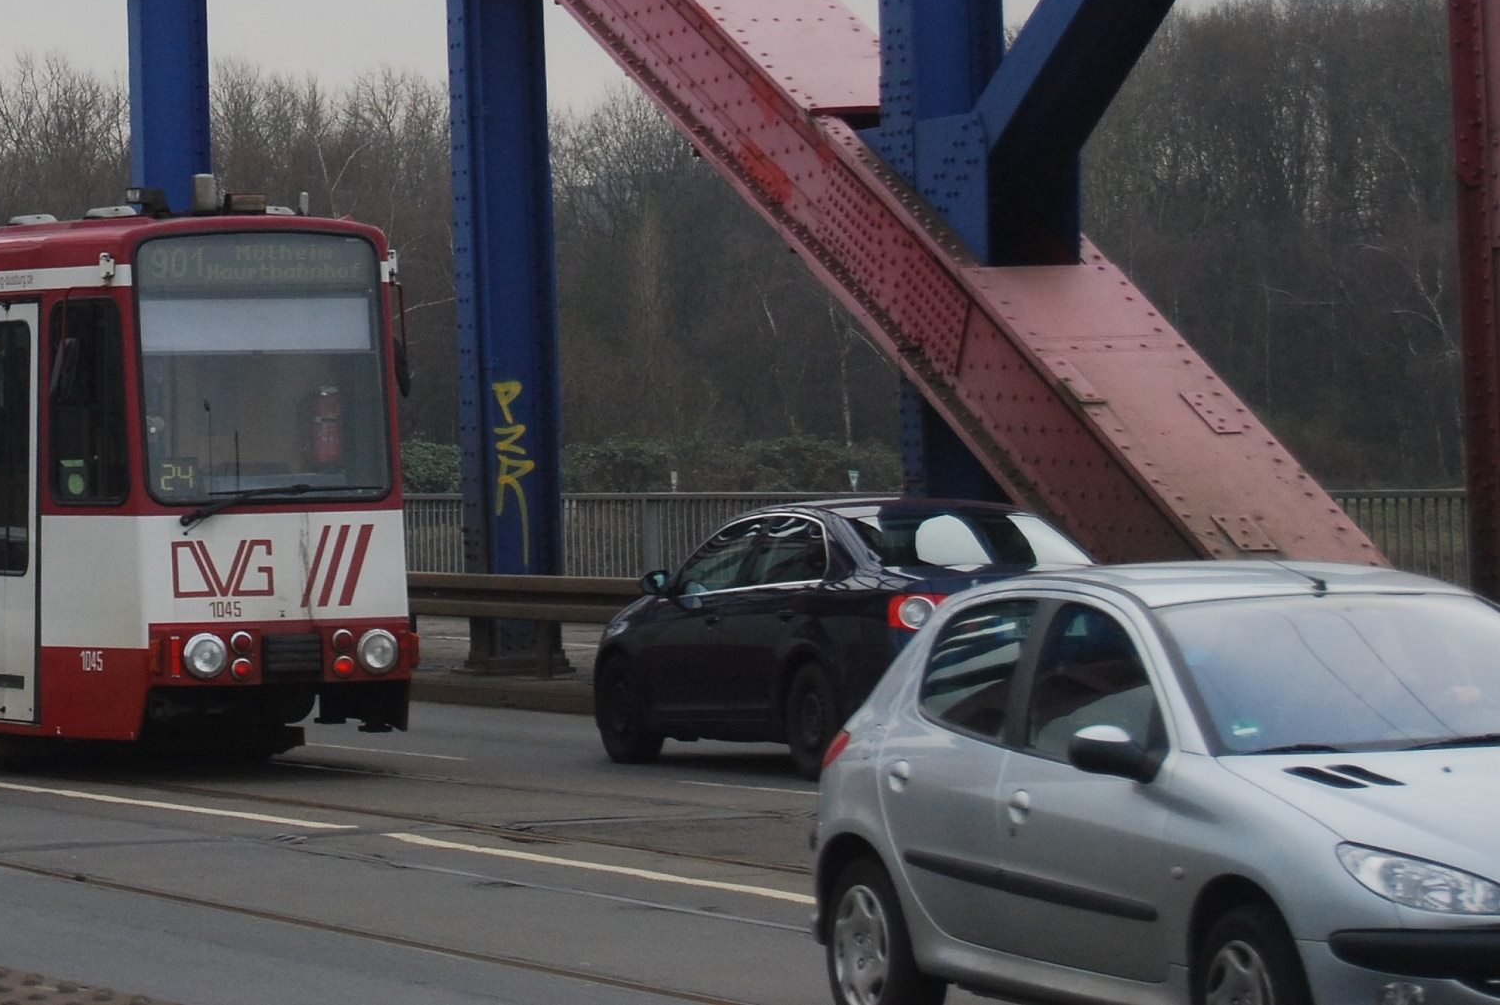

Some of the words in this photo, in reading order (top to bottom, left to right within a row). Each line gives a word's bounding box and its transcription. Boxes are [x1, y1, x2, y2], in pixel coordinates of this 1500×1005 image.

[151, 247, 205, 278] 901
[161, 464, 194, 491] 24
[171, 539, 275, 598] DVG
[208, 601, 242, 617] 1045
[80, 650, 104, 671] 1045
